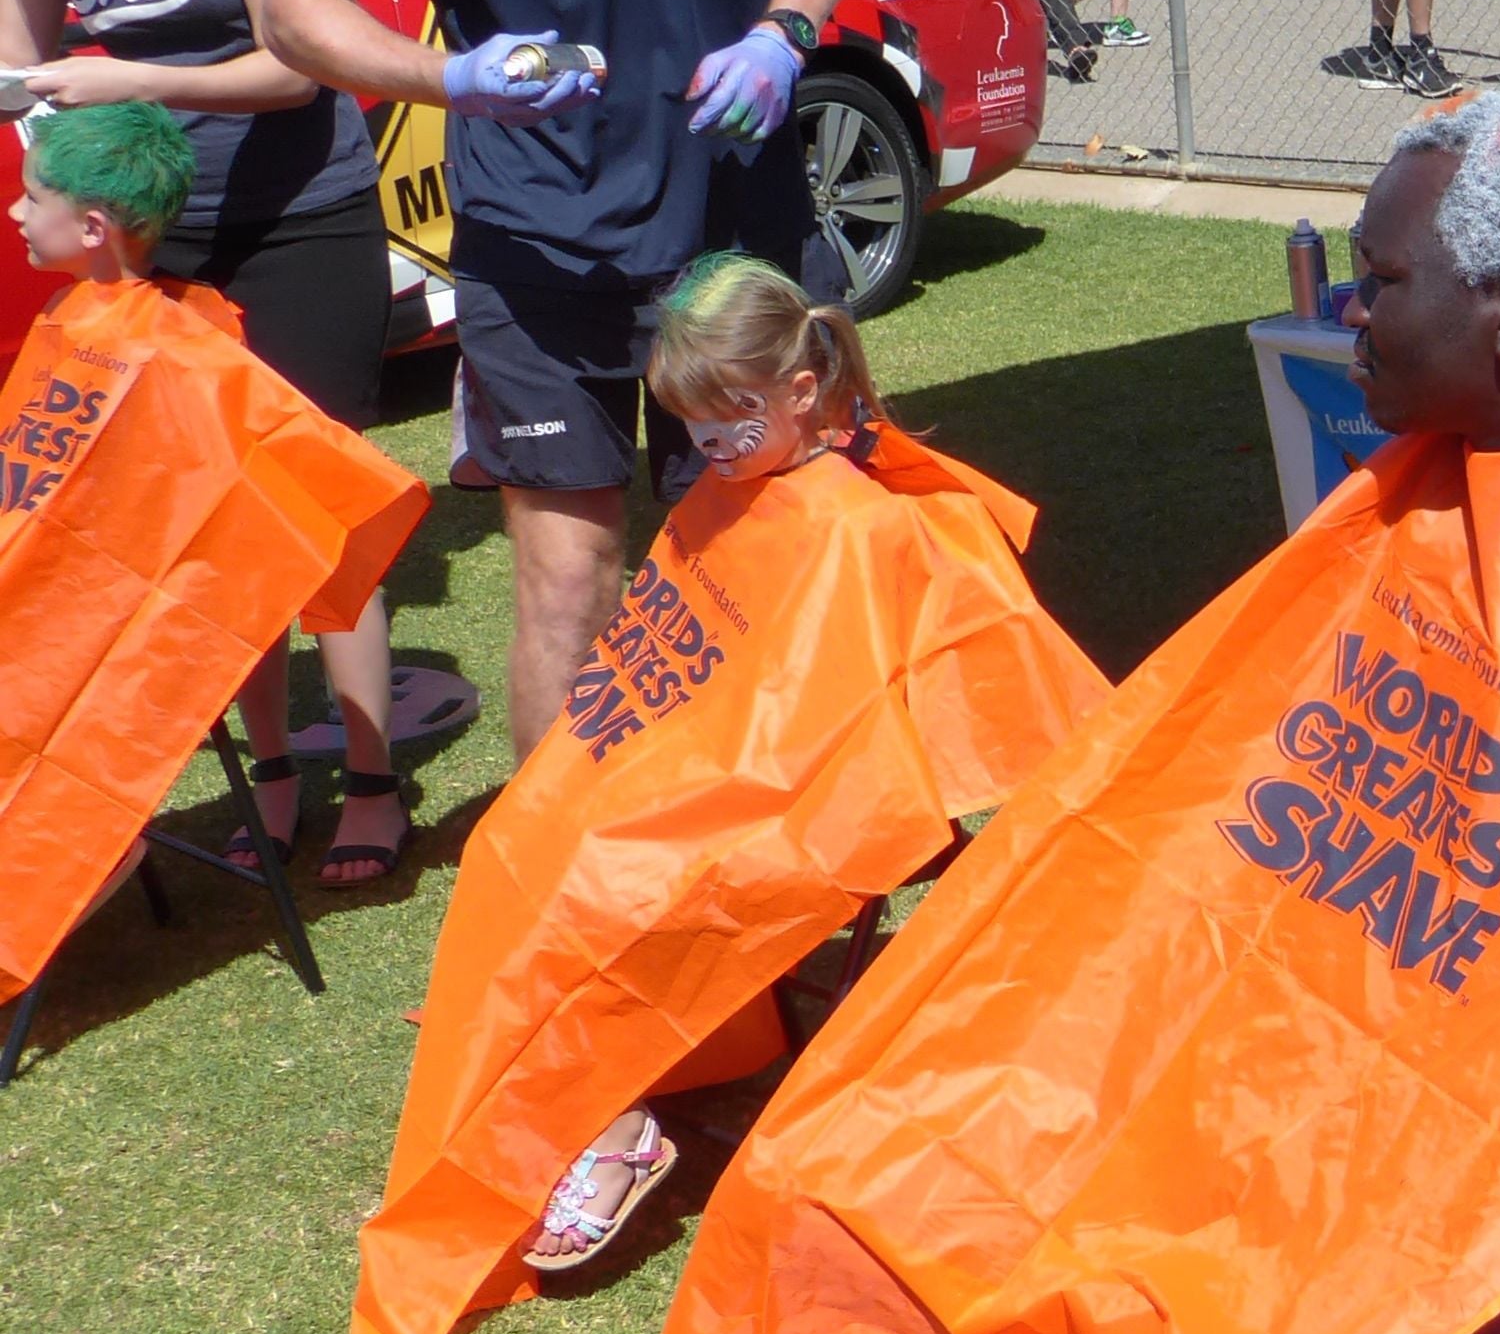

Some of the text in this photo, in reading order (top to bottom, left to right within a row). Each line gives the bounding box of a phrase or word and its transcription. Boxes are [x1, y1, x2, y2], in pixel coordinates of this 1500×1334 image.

[977, 65, 1024, 85] Leukaemia
[977, 83, 1025, 102] Foundation
[71, 345, 129, 375] ndation
[1324, 412, 1386, 435] Leuka
[627, 557, 725, 685] ORLD'S
[689, 556, 750, 635] Foundation
[1371, 575, 1473, 667] Leukaemia
[602, 606, 691, 721] EATEST
[565, 651, 646, 763] AVE
